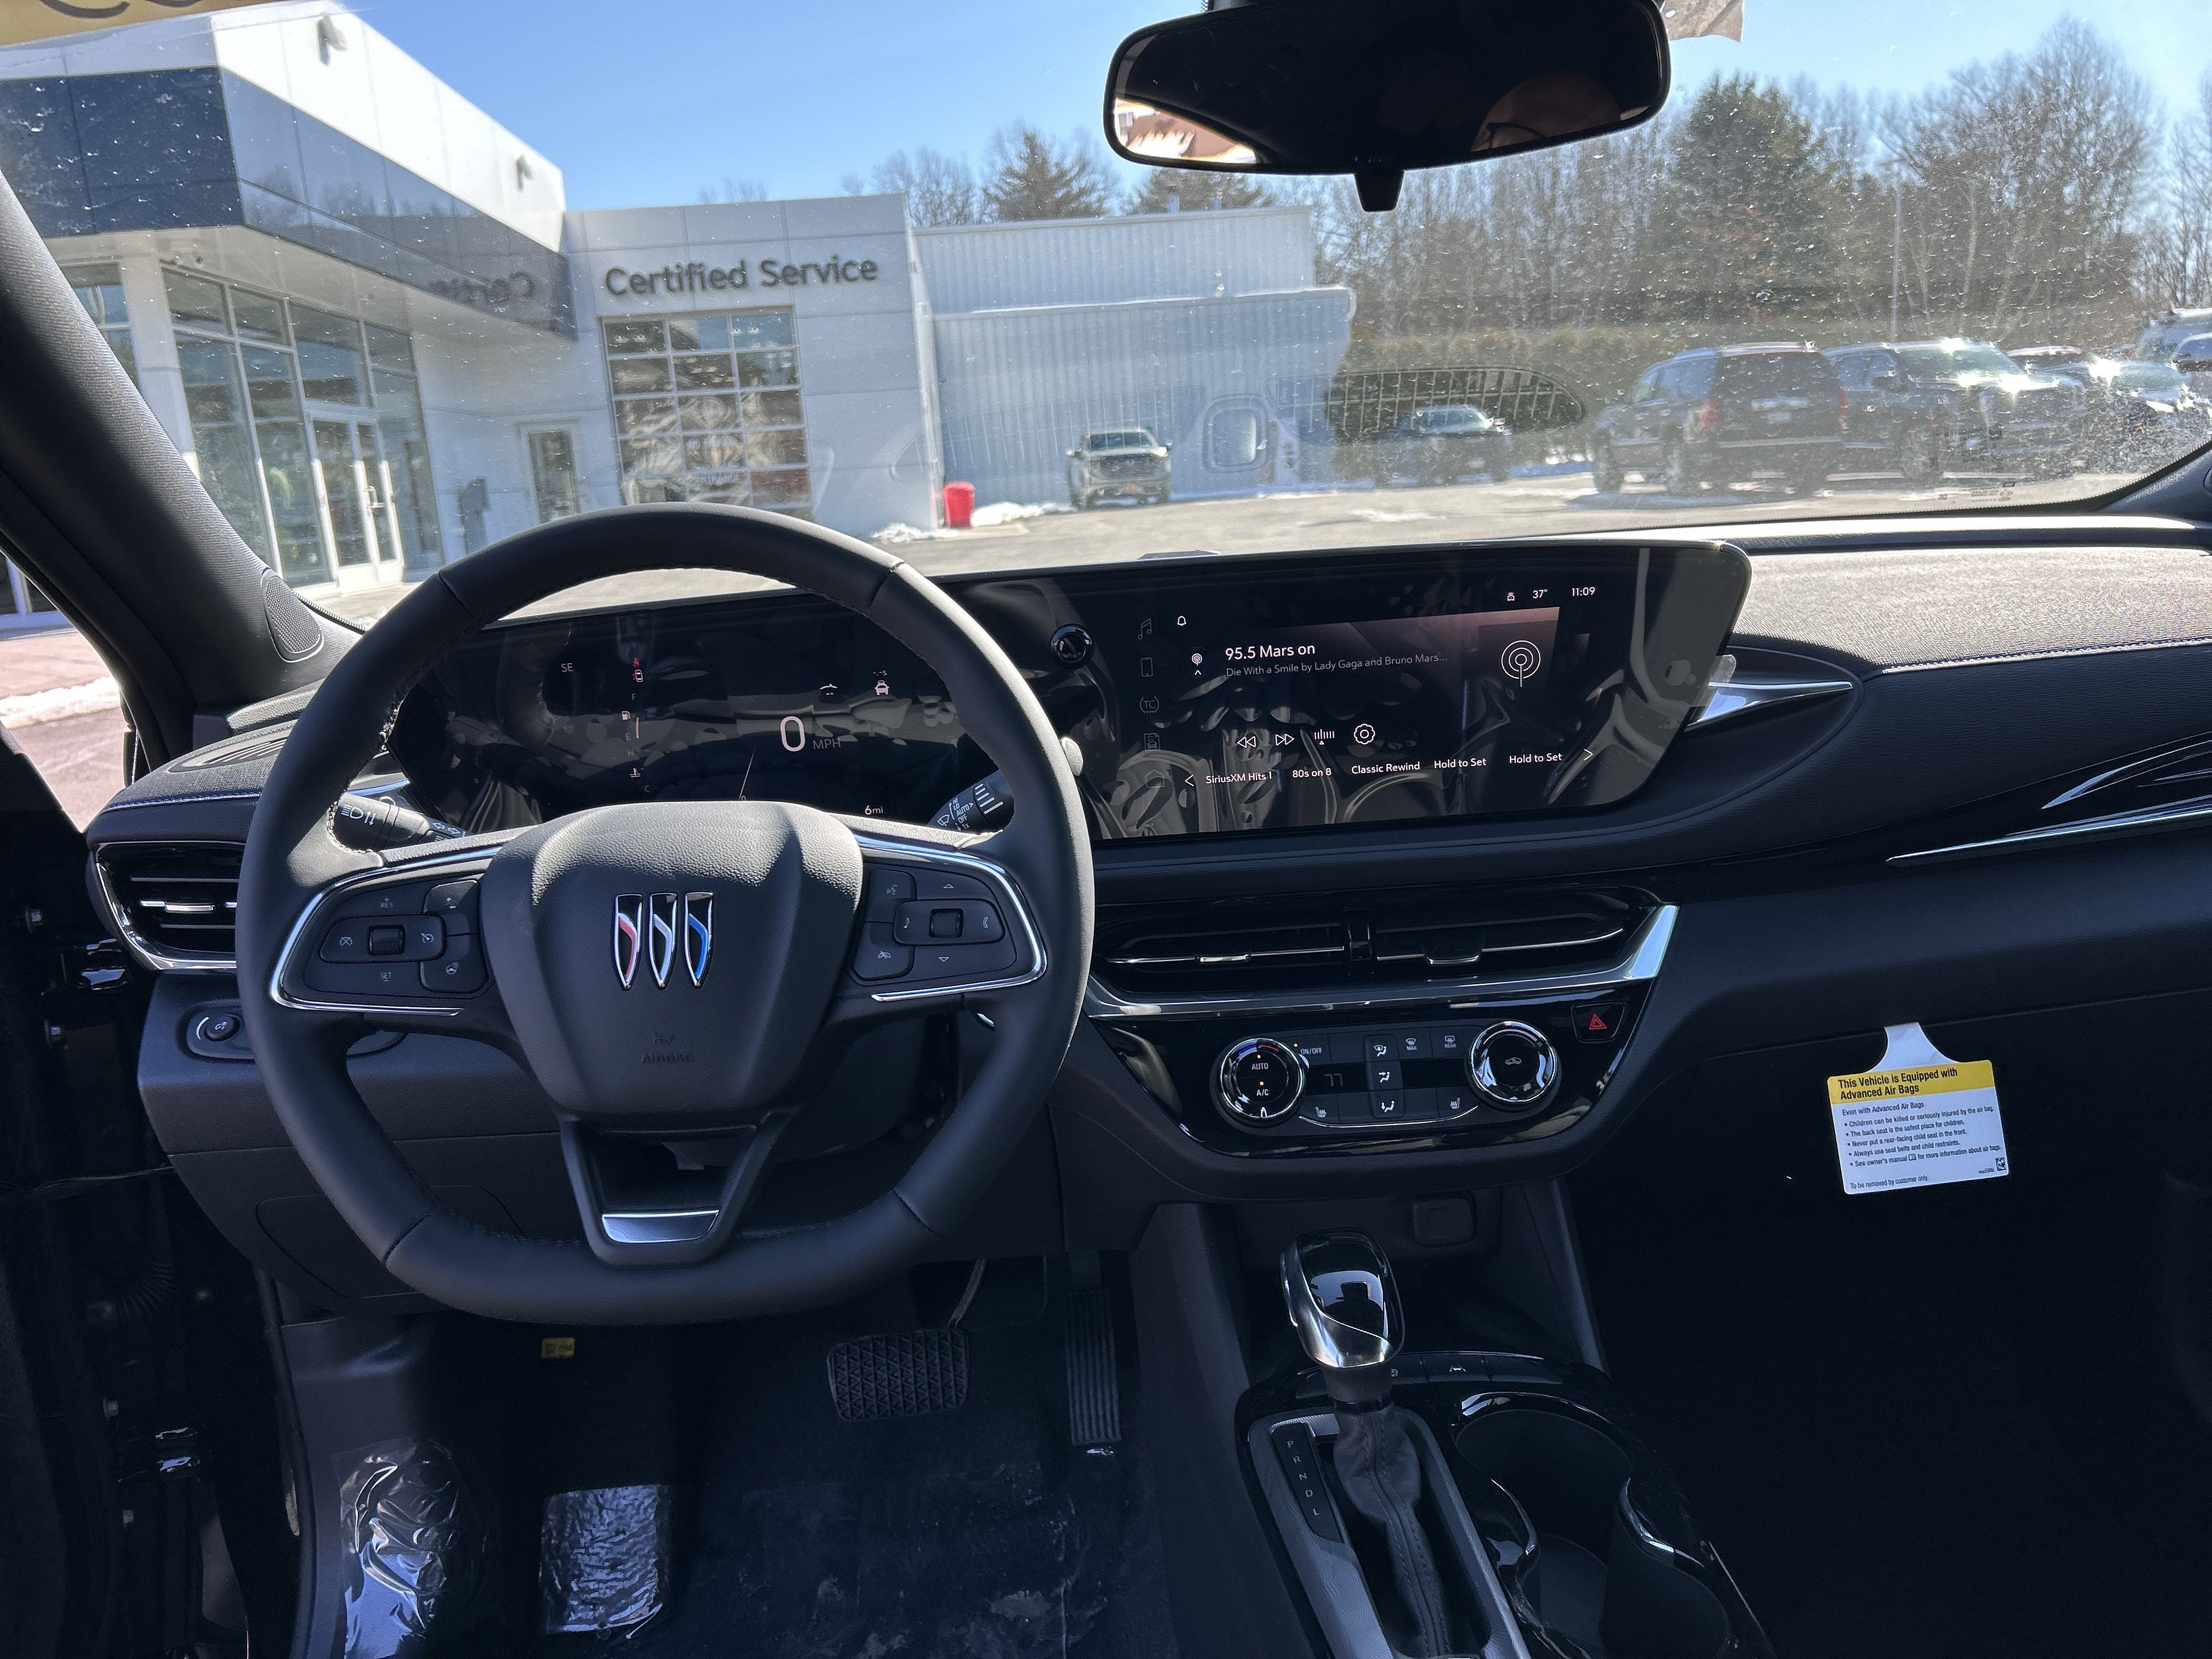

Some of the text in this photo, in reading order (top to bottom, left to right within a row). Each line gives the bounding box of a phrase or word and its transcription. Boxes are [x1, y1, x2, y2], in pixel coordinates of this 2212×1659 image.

[605, 255, 878, 295] Certified Service
[1532, 586, 1595, 599] 37° 11:09
[1225, 645, 1316, 661] 95.5 Mars on
[561, 663, 574, 673] SE
[1226, 668, 1242, 676] Die
[1244, 666, 1264, 675] With
[1274, 664, 1299, 673] Smile
[1301, 662, 1312, 673] by
[1314, 660, 1336, 671] Lady
[1338, 659, 1363, 670] Gaga
[1364, 657, 1383, 667] and
[1385, 656, 1413, 665] Bruno
[631, 693, 637, 701] F
[625, 732, 631, 741] E
[780, 715, 805, 752] 0
[812, 738, 842, 750] MPH
[1434, 757, 1487, 769] Hold to Set
[1509, 752, 1562, 764] Hold to Set
[1293, 767, 1332, 778] 80s on 8
[1351, 761, 1420, 775] Classic Rewind
[1206, 774, 1246, 784] SiriusXM
[1248, 771, 1266, 781] Hits
[953, 803, 960, 811] LO
[956, 804, 970, 817] AUTO
[957, 814, 967, 824] OFF
[1300, 1047, 1323, 1056] ON/OFF
[1251, 1062, 1269, 1070] AUTO
[1838, 1068, 1958, 1088] This Vehicle is Equipped with
[1841, 1085, 1920, 1099] Advanced Air Bags
[1872, 1104, 1900, 1113] Advanced
[1917, 1111, 1940, 1120] seriously
[1884, 1135, 1913, 1143] rear-facing
[1940, 1148, 1967, 1157] information
[1865, 1179, 1887, 1188] removed
[1895, 1176, 1917, 1184] customer
[1287, 1440, 1294, 1449] P
[1299, 1472, 1307, 1481] N
[1305, 1489, 1313, 1498] D
